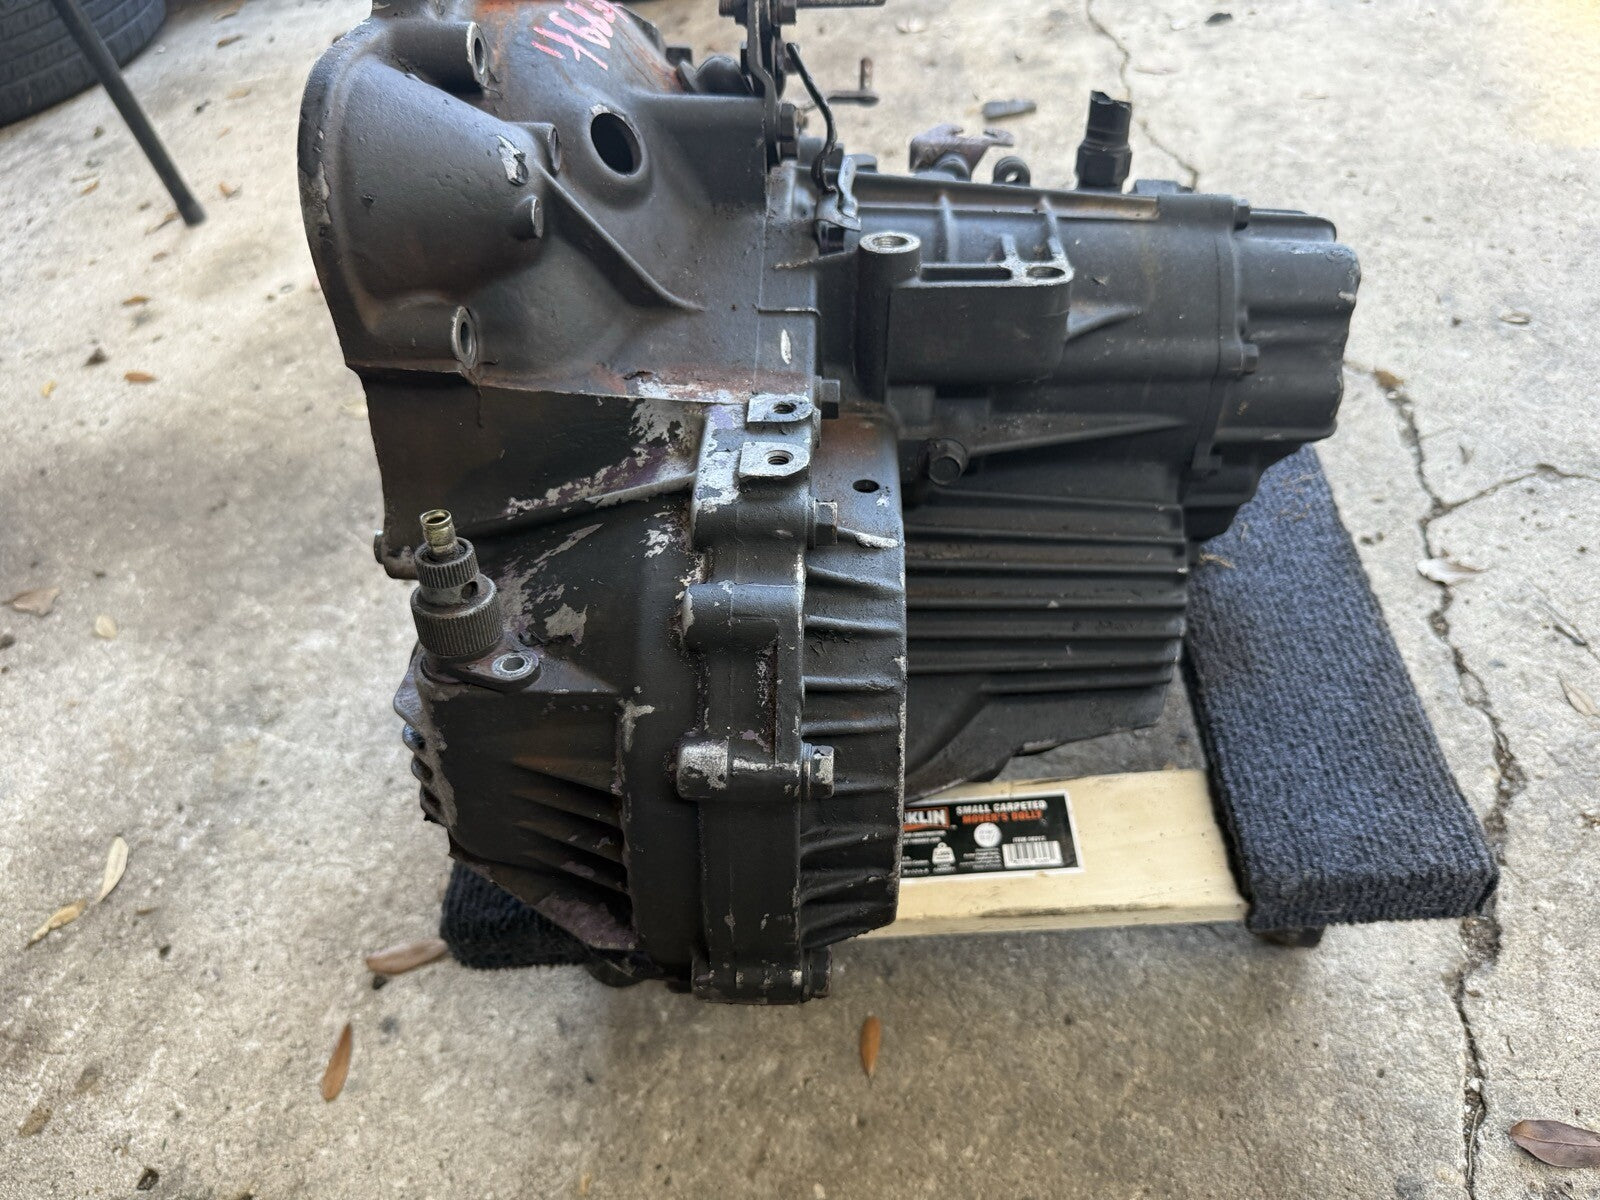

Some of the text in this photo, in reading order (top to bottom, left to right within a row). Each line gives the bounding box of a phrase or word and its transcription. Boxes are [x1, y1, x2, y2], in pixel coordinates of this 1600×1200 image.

[955, 800, 1047, 816] SMALL CARPETED
[962, 809, 1043, 824] MOVER'S DOLLY
